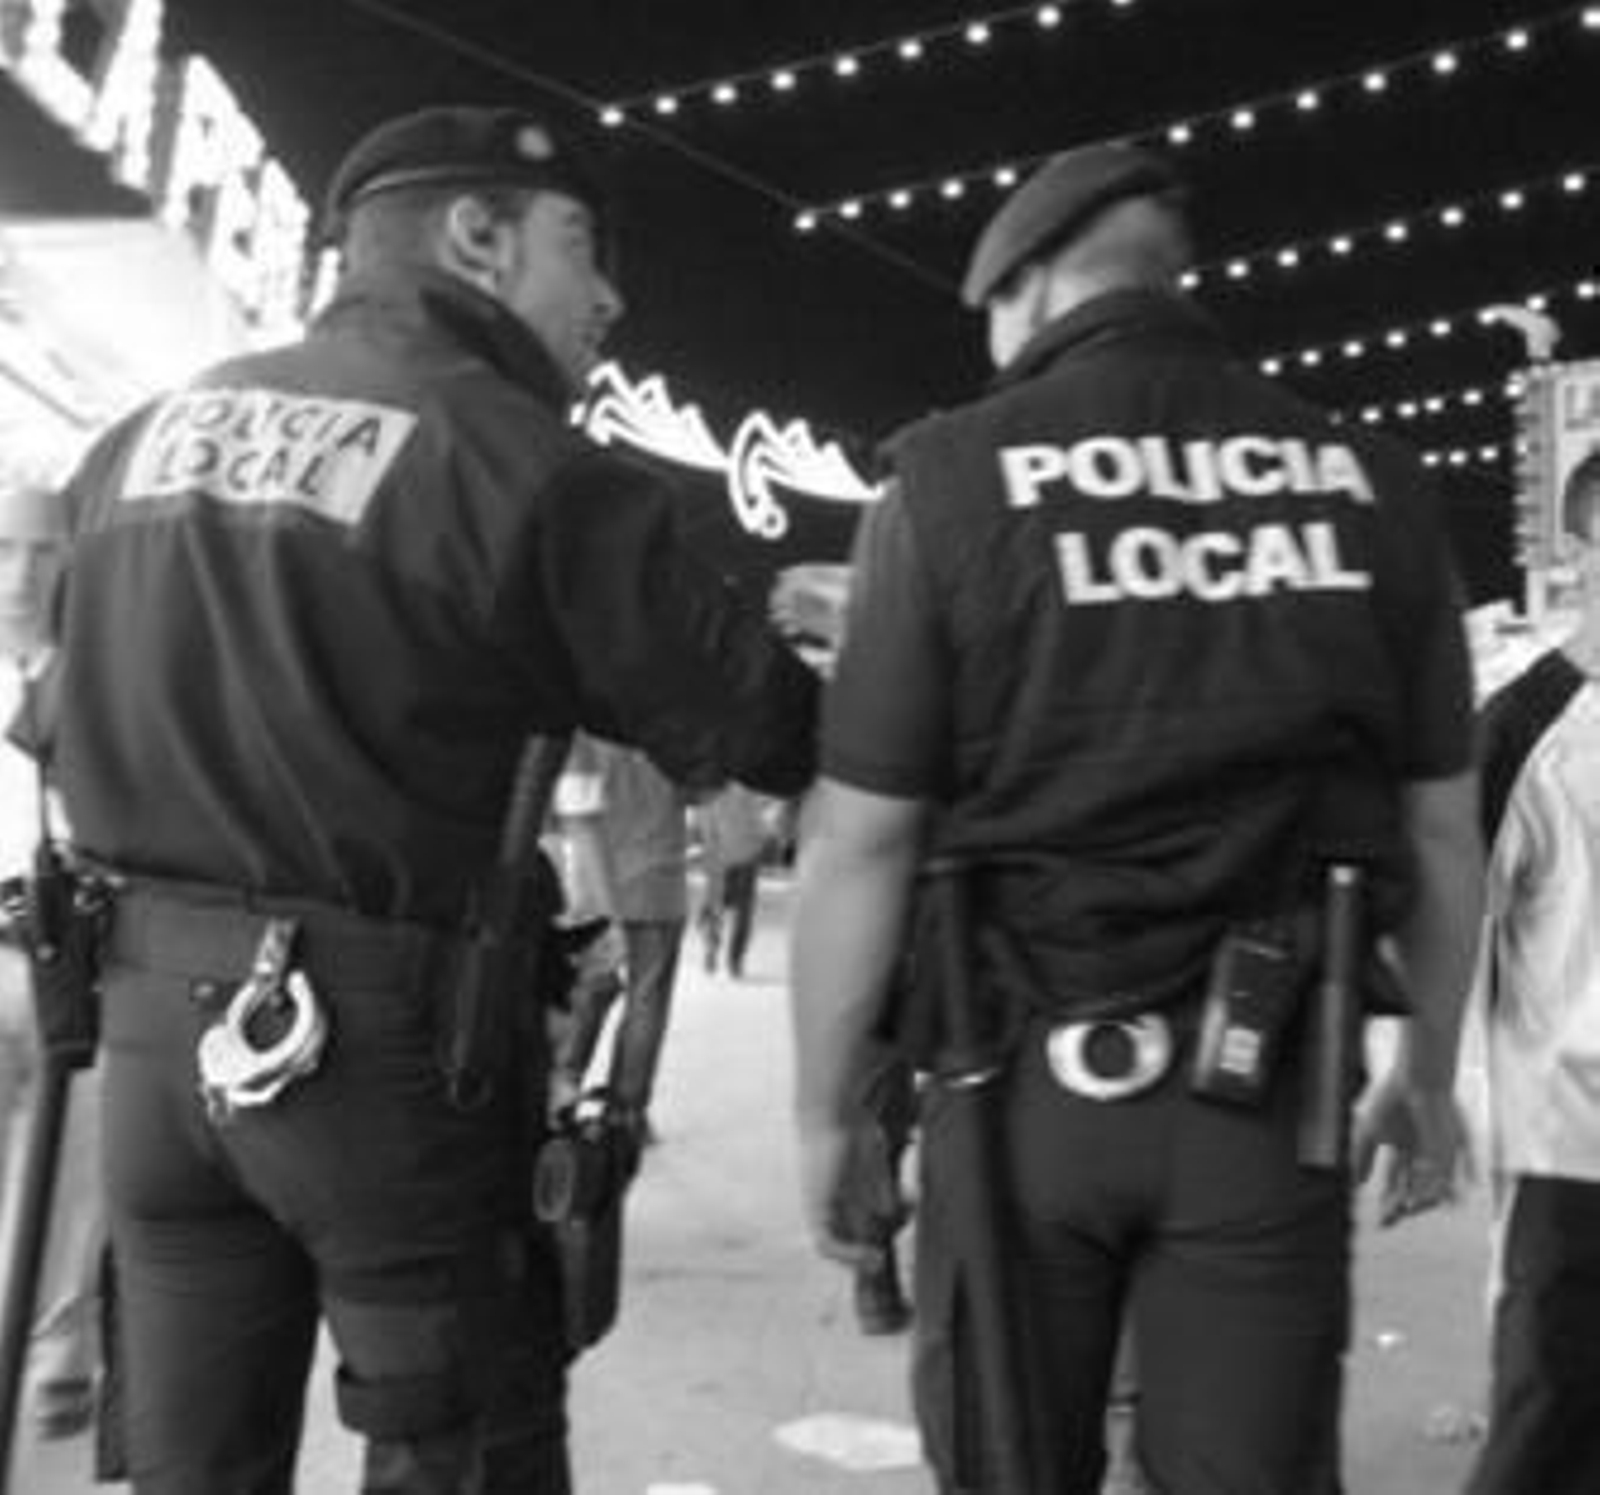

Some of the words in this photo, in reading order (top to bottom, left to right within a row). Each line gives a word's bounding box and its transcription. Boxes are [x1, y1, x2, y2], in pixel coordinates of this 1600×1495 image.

[153, 437, 324, 496] LOCAL
[1000, 435, 1374, 507] POLICIA
[1054, 521, 1371, 606] LOCAL
